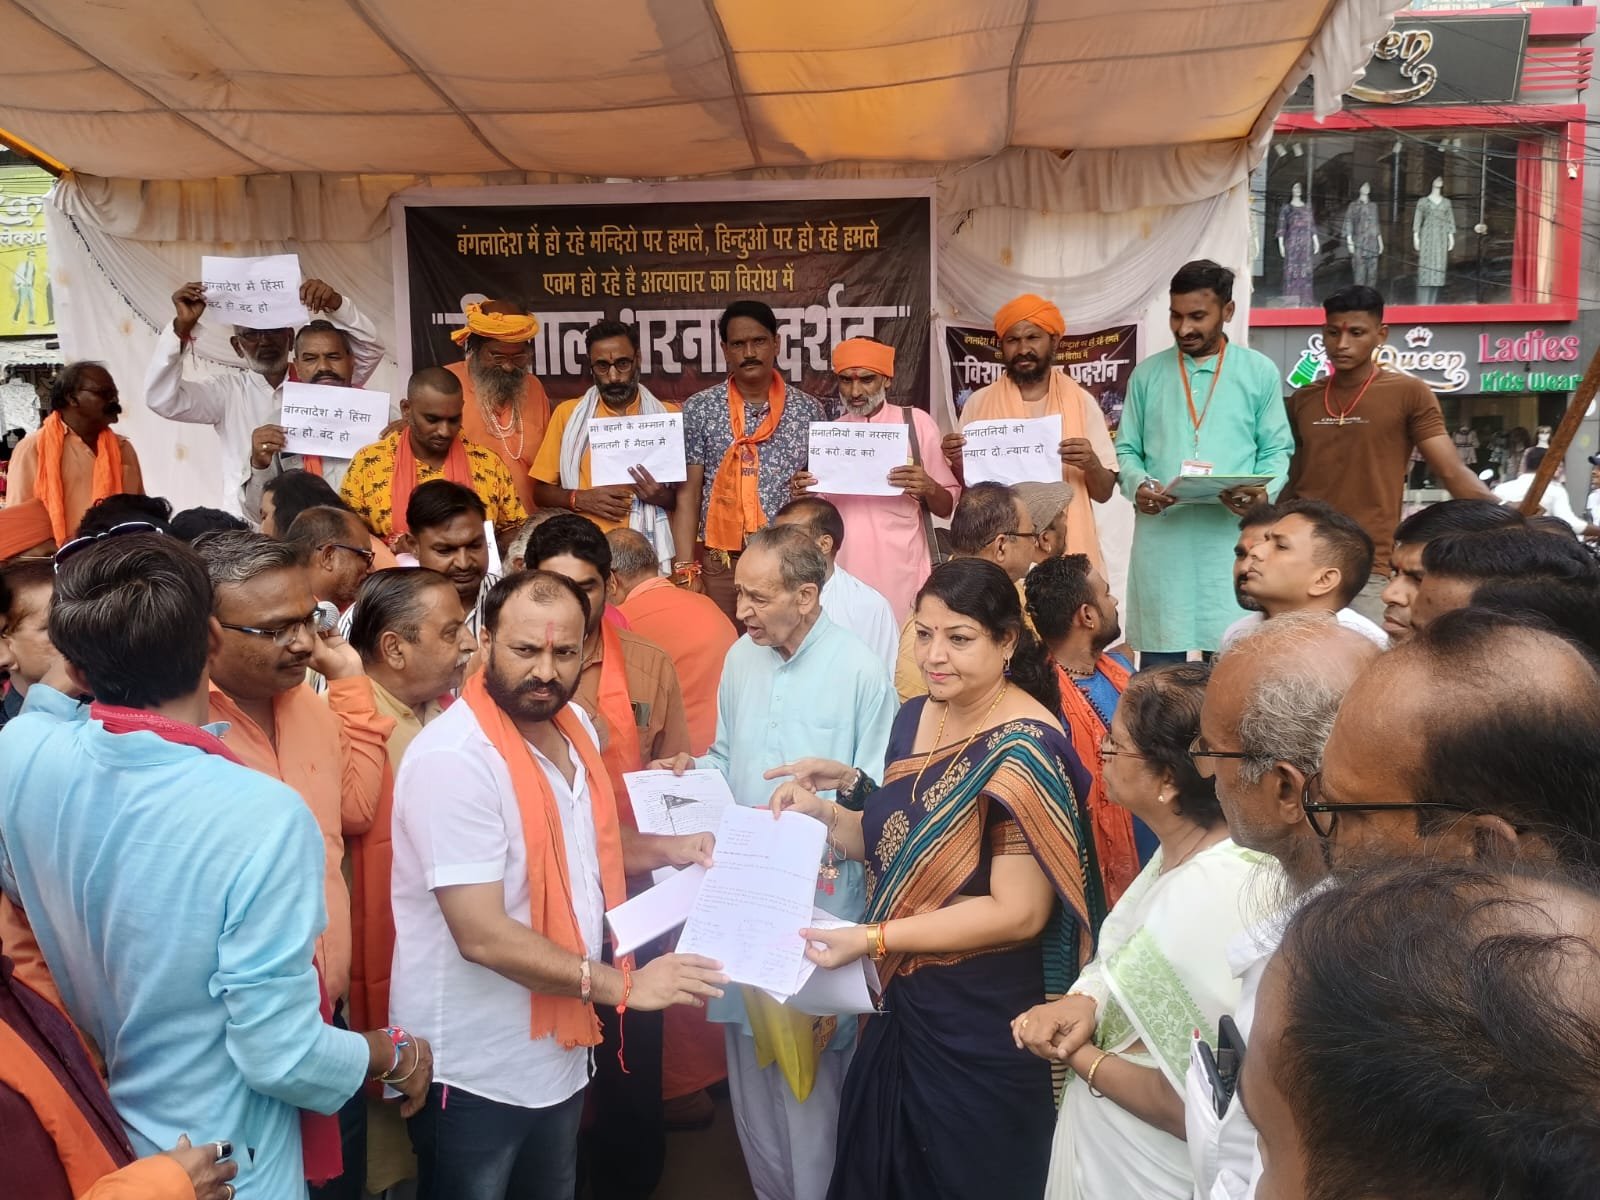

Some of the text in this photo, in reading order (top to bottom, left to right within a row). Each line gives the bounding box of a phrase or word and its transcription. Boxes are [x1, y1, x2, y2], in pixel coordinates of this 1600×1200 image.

[457, 224, 523, 257] बंगलादेश
[527, 223, 540, 254] में
[544, 226, 560, 256] हो
[565, 225, 585, 256] रहे
[589, 224, 638, 255] मन्दिरो
[642, 230, 663, 253] पर
[667, 223, 710, 256] हमले,
[772, 227, 793, 250] पर
[798, 221, 814, 252] हो
[819, 221, 838, 251] रहे
[843, 219, 879, 251] हमले
[543, 263, 795, 297] एवम हो रहे है अत्याचार का विरोध में
[258, 301, 269, 313] हो
[1478, 328, 1580, 364] Ladies
[1371, 344, 1470, 392] Queen
[1480, 370, 1584, 392] Kids Wear
[340, 430, 350, 441] हो
[854, 430, 866, 438] का
[1013, 424, 1024, 434] को
[860, 448, 876, 457] करो
[963, 448, 987, 458] न्याय
[1034, 444, 1044, 454] दो
